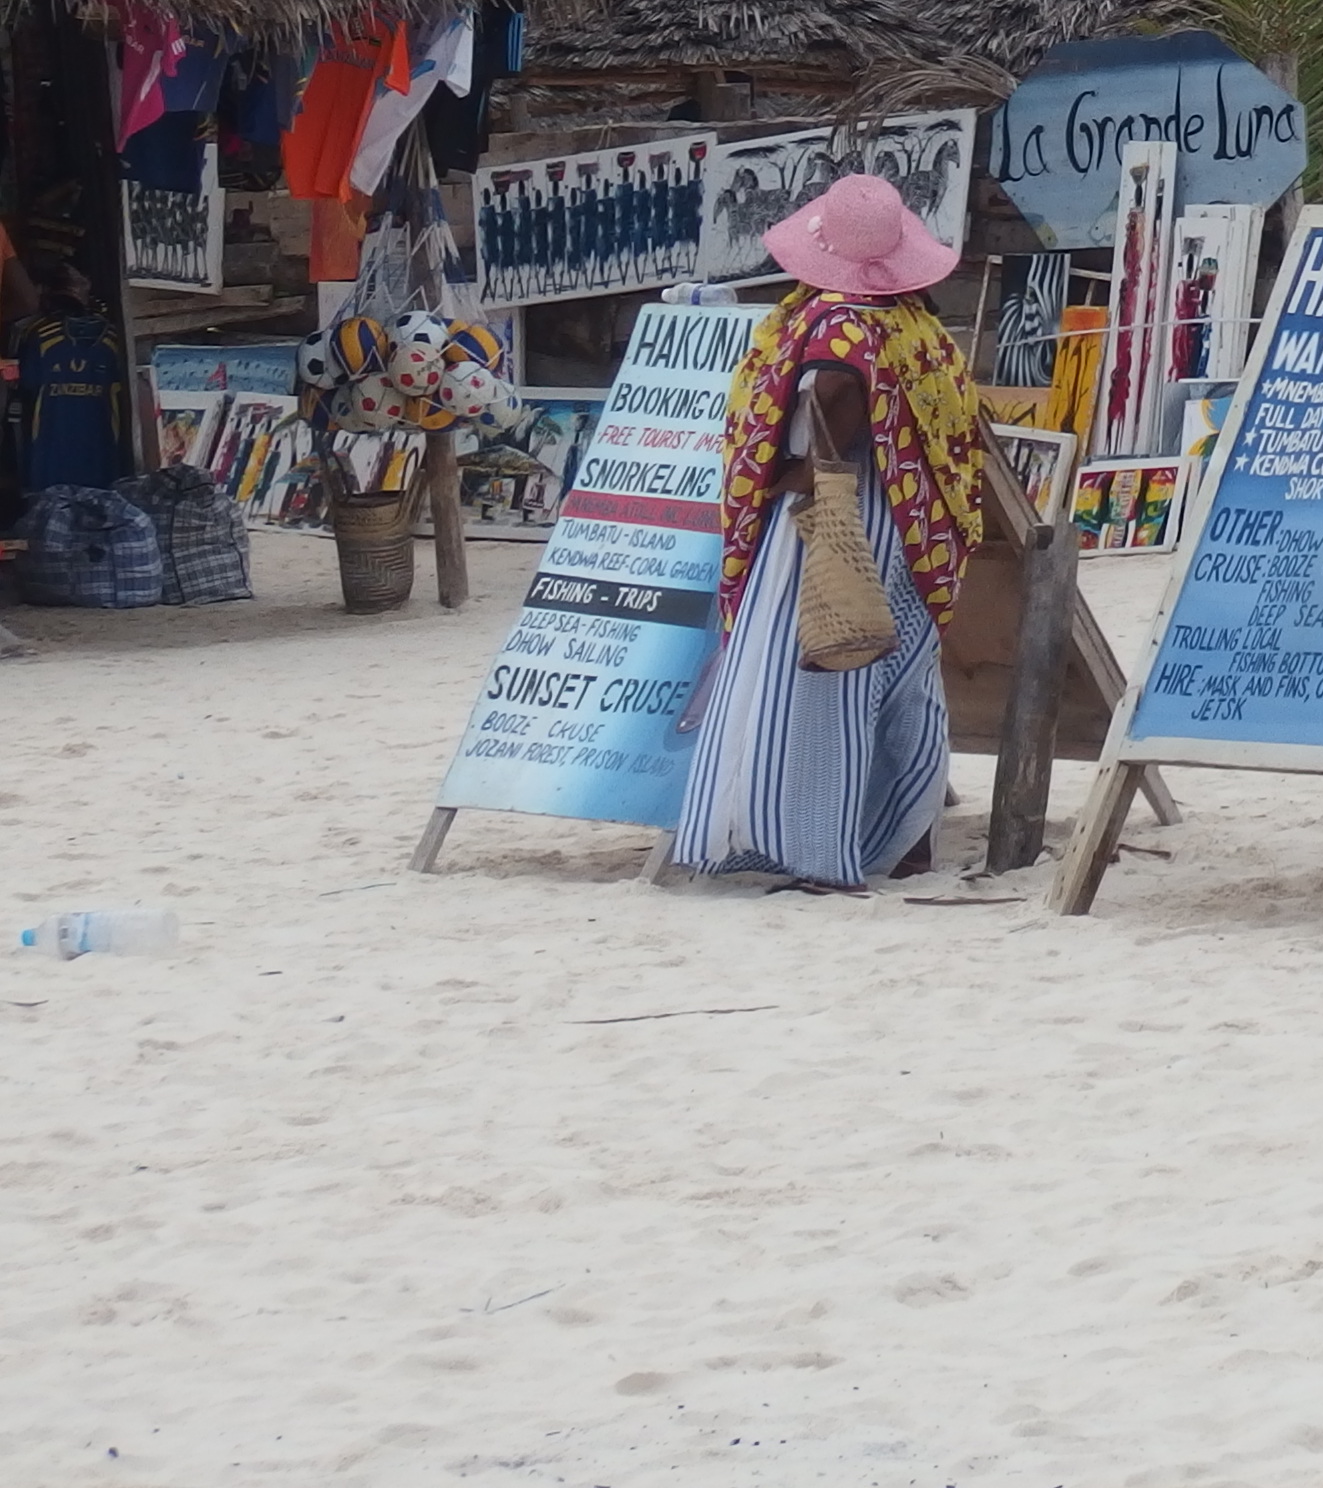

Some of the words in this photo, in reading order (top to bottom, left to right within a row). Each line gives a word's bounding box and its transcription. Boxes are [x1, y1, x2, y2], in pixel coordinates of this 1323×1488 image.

[997, 99, 1050, 182] La
[1065, 64, 1204, 180] Grande
[1213, 62, 1298, 160] Luna
[610, 383, 710, 420] BOOKING
[1254, 403, 1295, 428] FULL
[599, 424, 638, 446] FREE
[637, 427, 696, 449] TOURIST
[1250, 453, 1310, 476] KENDWA
[580, 458, 716, 499] SNORKELING
[530, 577, 597, 604] FISHING
[615, 587, 662, 612] TRIPS
[1256, 579, 1315, 605] FISHING
[1248, 605, 1287, 626] DEEP
[505, 630, 556, 657] DHOW
[563, 638, 628, 667] SAILING
[1172, 625, 1242, 651] TROLLING
[1242, 627, 1283, 650] LOCAL
[1228, 651, 1279, 673] FISHING
[487, 665, 598, 710] SUNSET
[600, 678, 691, 715] CRUSE
[1242, 675, 1273, 697] AND
[481, 711, 537, 736] BOOZE
[465, 738, 525, 758] JOZANI
[569, 747, 628, 772] PRISON
